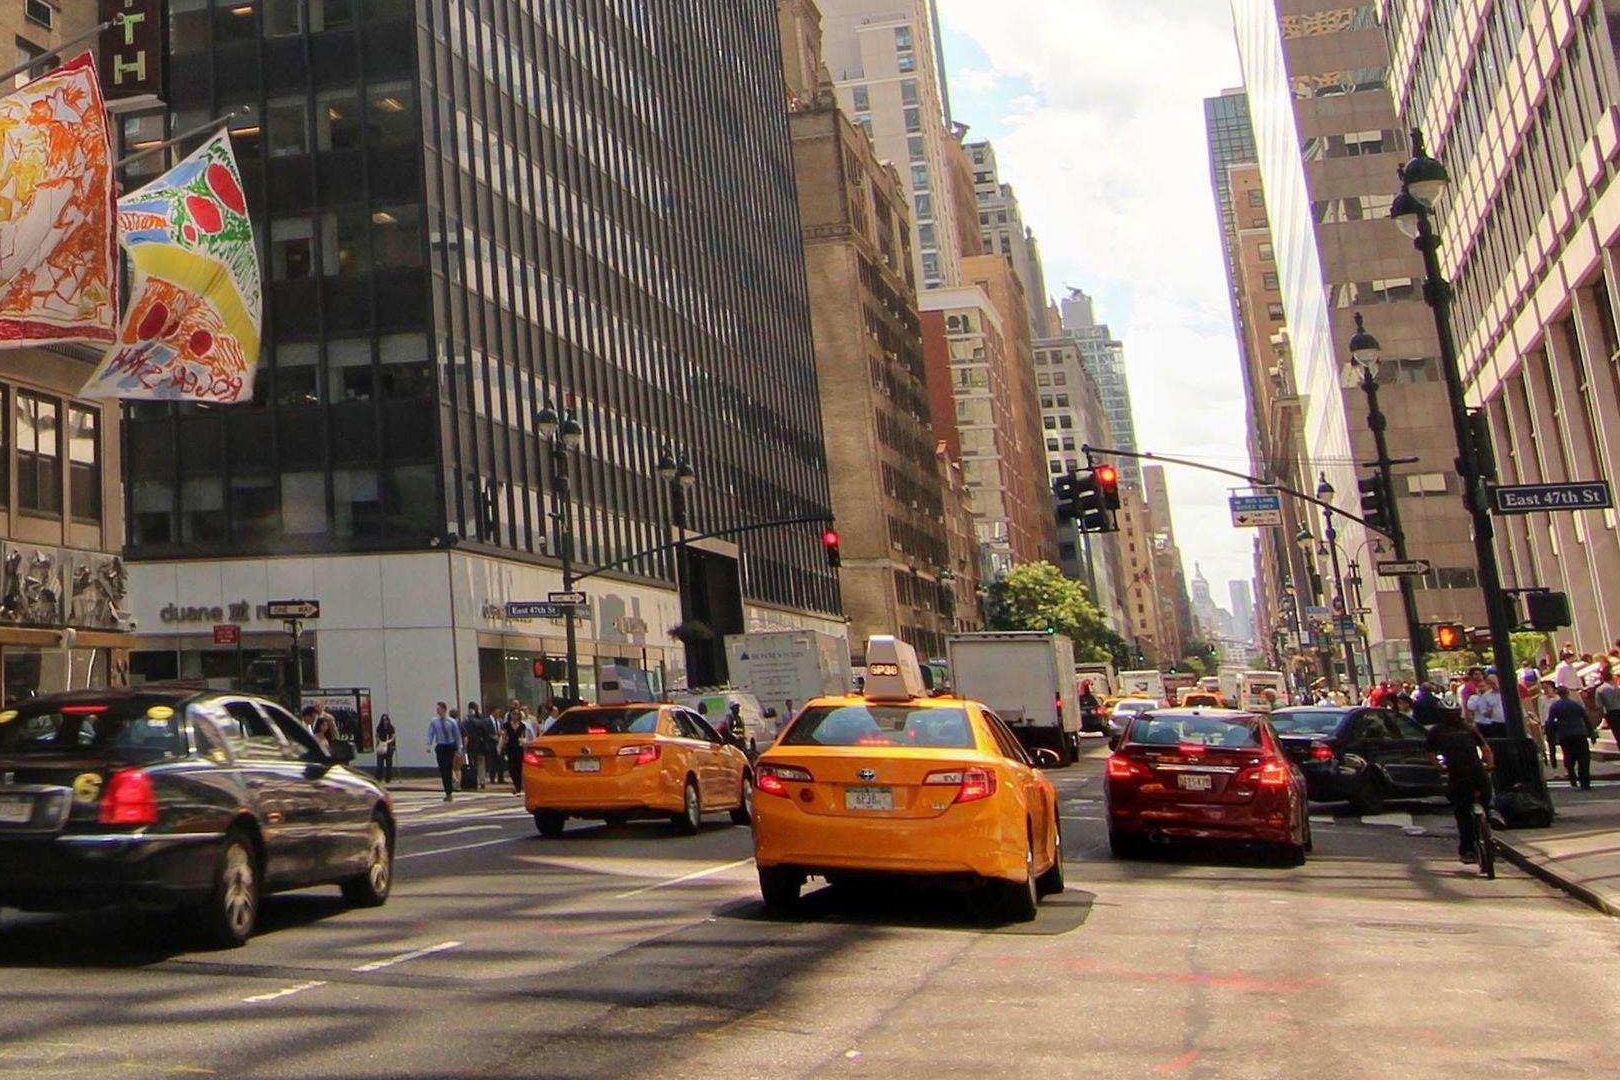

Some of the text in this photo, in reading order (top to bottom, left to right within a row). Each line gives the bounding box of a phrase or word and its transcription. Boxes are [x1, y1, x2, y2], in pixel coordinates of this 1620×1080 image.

[1504, 489, 1600, 506] East 47th St
[160, 602, 223, 622] duane
[511, 606, 556, 615] East 47th St
